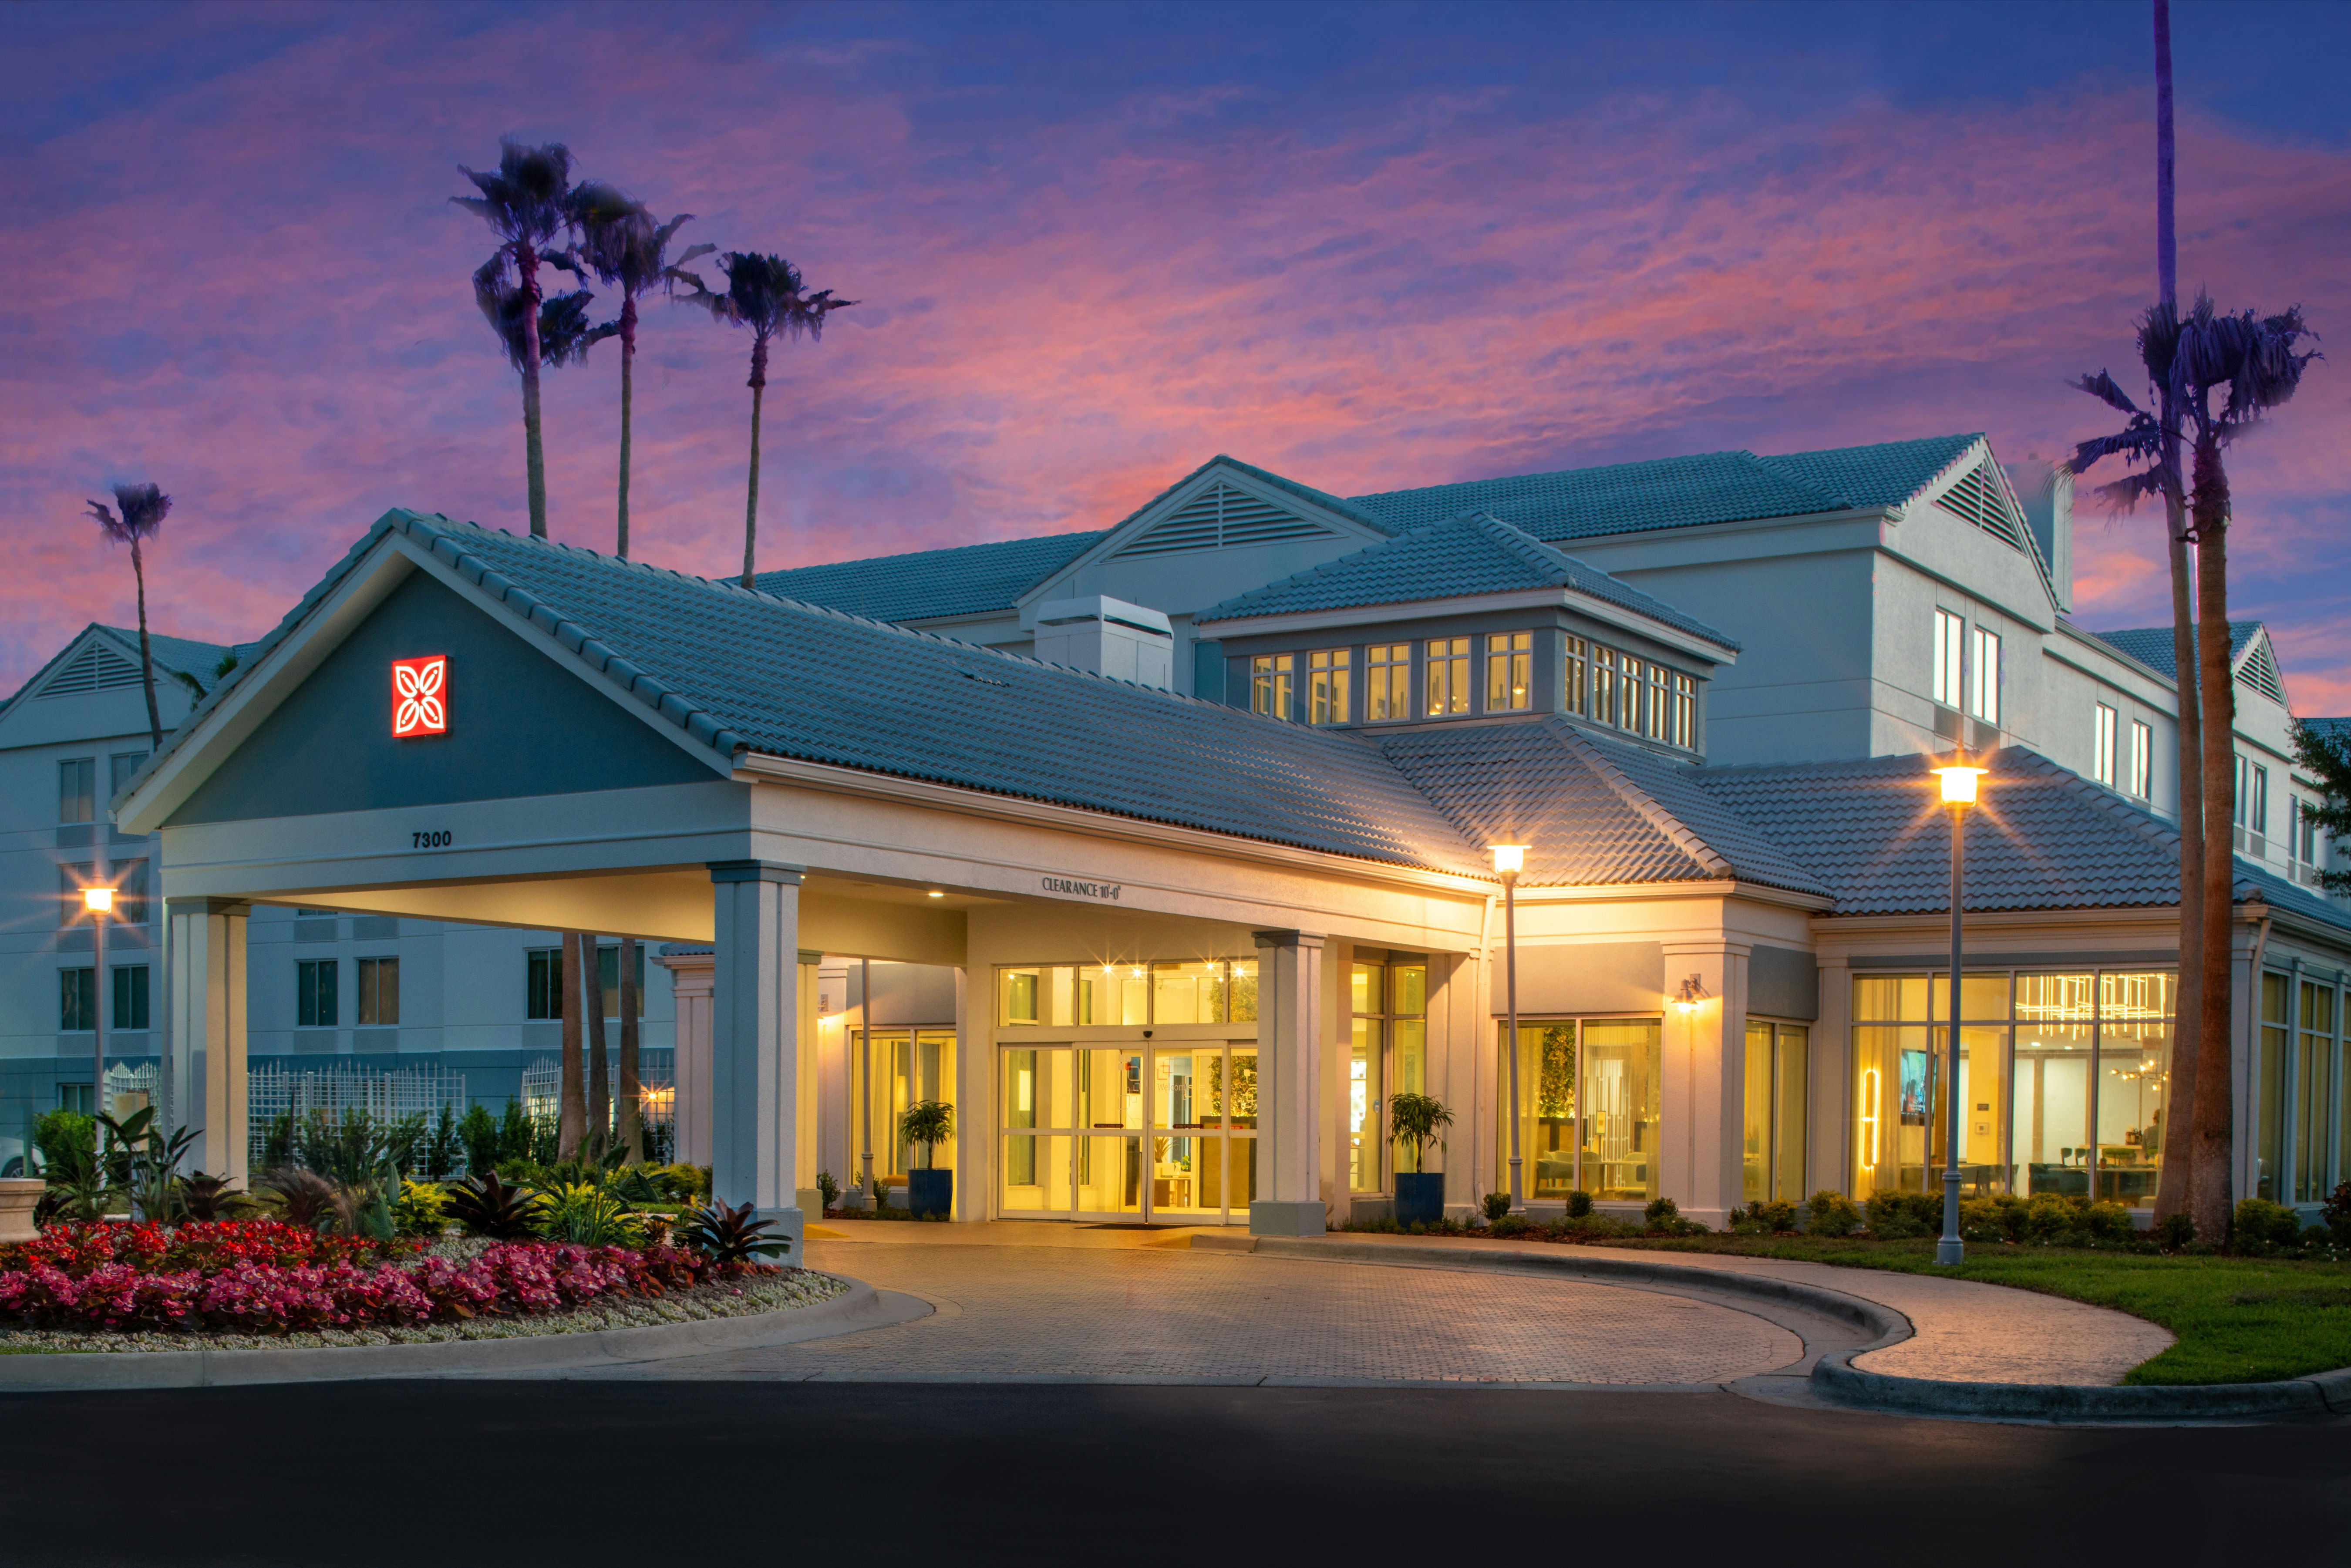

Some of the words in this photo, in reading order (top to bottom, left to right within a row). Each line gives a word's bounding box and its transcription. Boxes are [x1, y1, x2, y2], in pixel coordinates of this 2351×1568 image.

[412, 830, 452, 848] 7300
[1042, 877, 1098, 897] CLEARANCE
[1157, 1083, 1190, 1091] Welcome
